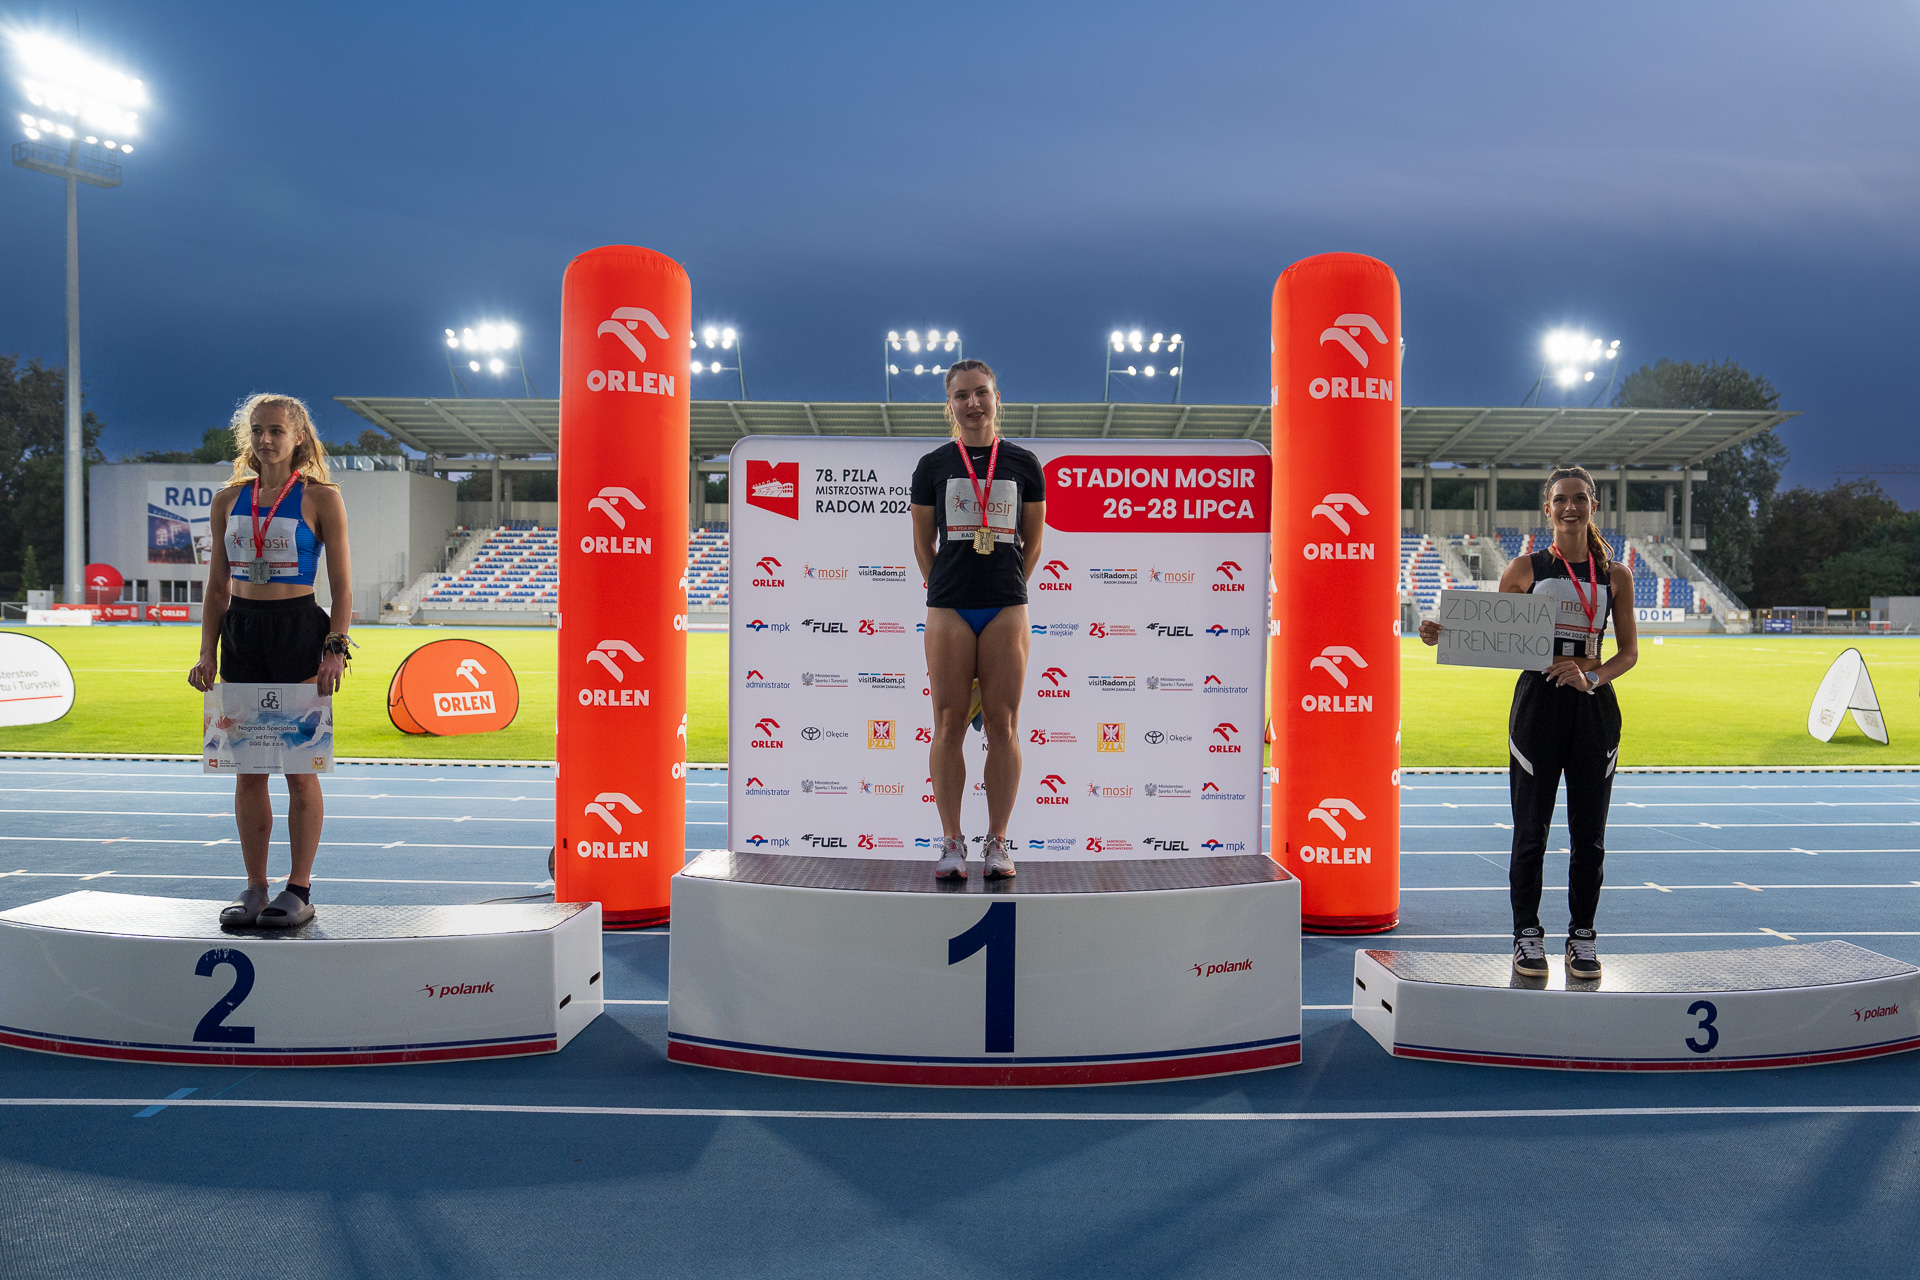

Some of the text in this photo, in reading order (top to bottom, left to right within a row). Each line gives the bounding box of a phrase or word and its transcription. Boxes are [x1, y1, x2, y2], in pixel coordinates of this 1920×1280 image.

[587, 370, 674, 396] ORLEN
[1309, 377, 1392, 401] ORLEN
[816, 469, 878, 482] 78. PZLA
[1058, 468, 1255, 488] STADION MOSIR
[816, 486, 885, 495] MISTRZOSTWA
[816, 500, 875, 513] RADOM
[1184, 500, 1254, 519] LIPCA
[580, 536, 651, 554] ORLEN
[1303, 543, 1374, 560] ORLEN
[819, 567, 848, 578] mosir
[859, 569, 906, 577] visitRadom.pl
[1090, 572, 1137, 580] visitRadom.pl
[1165, 570, 1195, 581] mosir
[753, 579, 784, 587] ORLEN
[1039, 582, 1072, 591] ORLEN
[1446, 599, 1552, 625] ZDROWIA
[1640, 610, 1672, 620] DOM
[771, 622, 790, 633] mpk
[813, 622, 848, 633] FUEL
[1158, 626, 1194, 637] FUEL
[1231, 627, 1250, 637] mpk
[1445, 628, 1551, 656] TRENERKO
[0, 670, 38, 679] terstwo
[19, 679, 60, 690] Turystyki
[579, 689, 649, 706] ORLEN
[439, 695, 491, 712] ORLEN
[1301, 695, 1372, 712] ORLEN
[751, 740, 783, 748] ORLEN
[870, 739, 894, 748] PZLA
[875, 783, 905, 794] mosir
[1103, 785, 1133, 796] mosir
[771, 838, 790, 848] mpk
[813, 837, 847, 848] FUEL
[1154, 840, 1189, 851] FUEL
[1226, 841, 1245, 851] mpk
[577, 840, 648, 858] ORLEN
[1300, 846, 1371, 864] ORLEN
[1206, 958, 1253, 977] polanik
[948, 902, 1016, 1053] 1
[439, 981, 495, 998] polanik
[192, 948, 256, 1044] 2
[1863, 1003, 1899, 1022] polanik
[1685, 1000, 1719, 1054] 3
